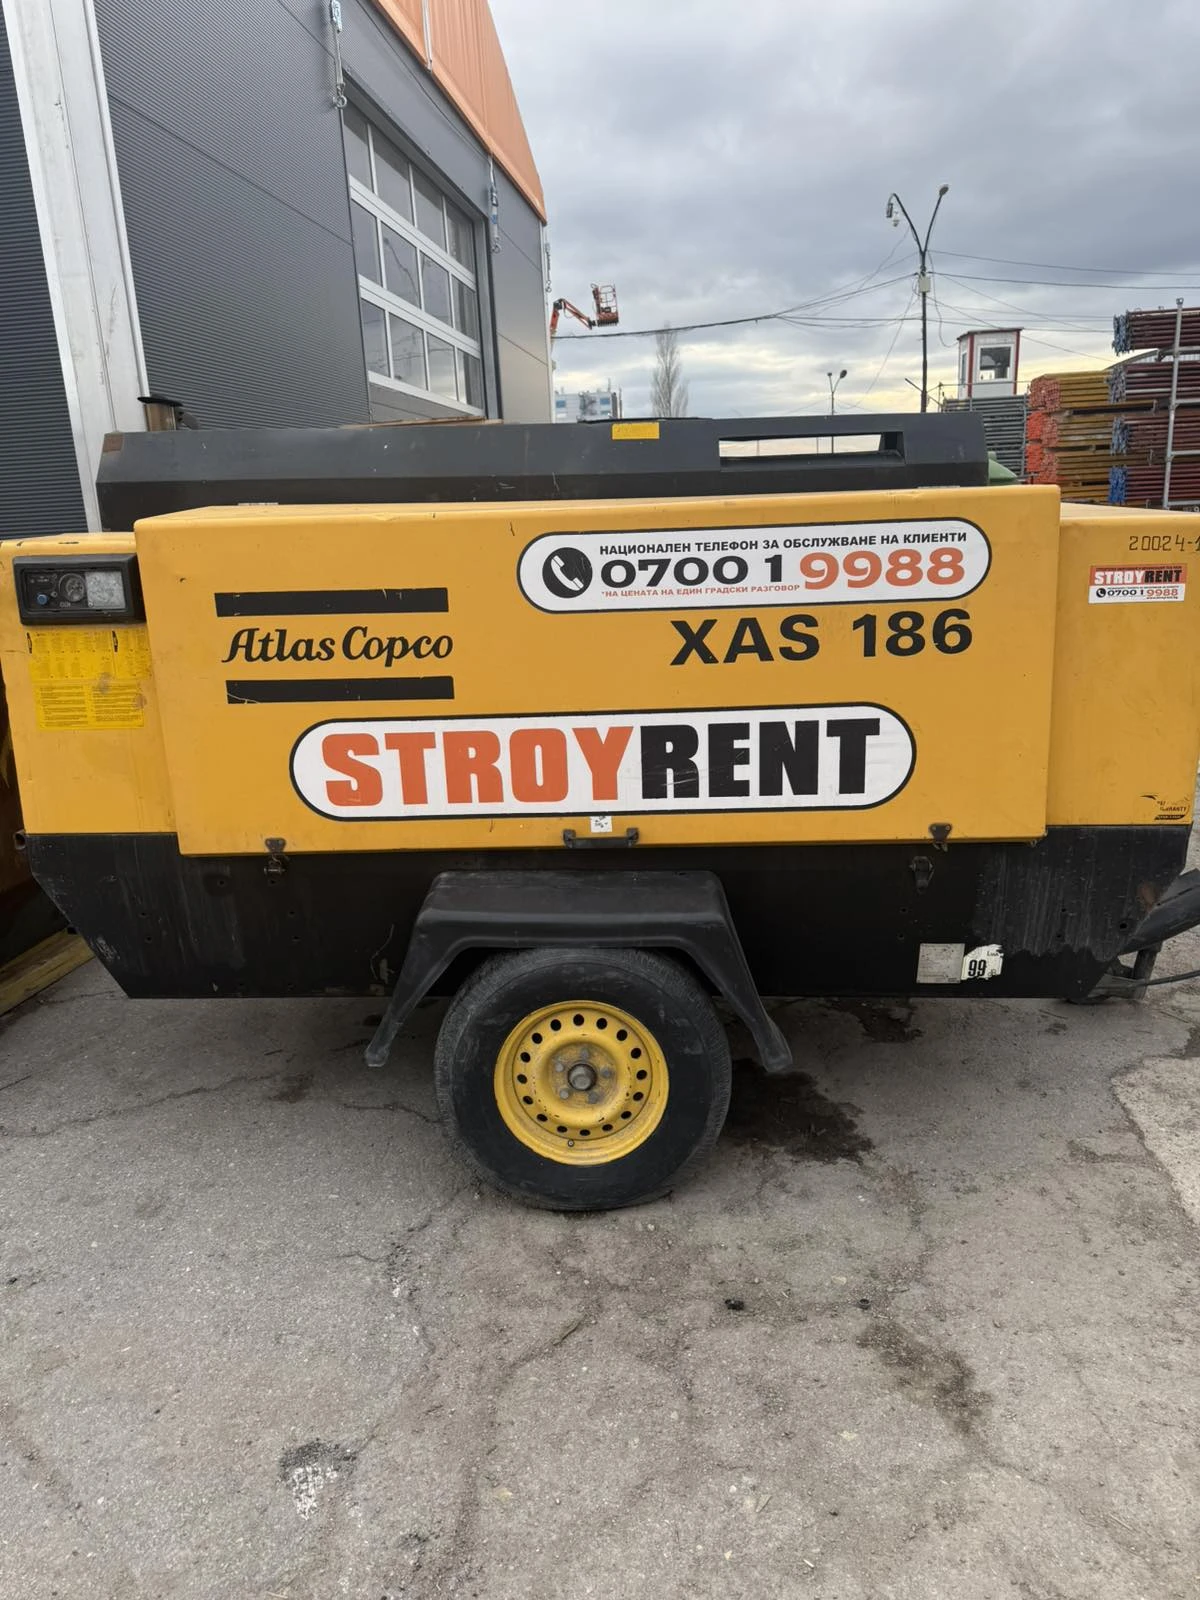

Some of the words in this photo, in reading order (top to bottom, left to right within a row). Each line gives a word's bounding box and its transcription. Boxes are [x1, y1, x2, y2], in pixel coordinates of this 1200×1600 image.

[600, 543, 691, 556] НАЦИОНАЛЕН
[695, 540, 758, 552] ТЕЛЕФОН
[762, 539, 780, 550] ЗА
[783, 536, 876, 549] ОБСЛУЖВАНЕ
[880, 534, 899, 545] НА
[903, 532, 967, 544] КЛИЕНТИ
[799, 547, 965, 590] 9988
[1094, 569, 1182, 584] STROYRENT
[621, 588, 658, 597] ЦЕНАТА
[677, 587, 702, 595] ЕДИН
[705, 586, 748, 594] ГРАДСКИ
[751, 584, 800, 592] РАЗГОВОР
[1146, 589, 1179, 597] 9988
[221, 627, 336, 663] Atlas
[342, 626, 454, 667] Copco
[669, 613, 820, 666] XAS
[852, 608, 973, 657] 186
[321, 717, 881, 808] STROYRENT
[968, 959, 987, 977] 99
